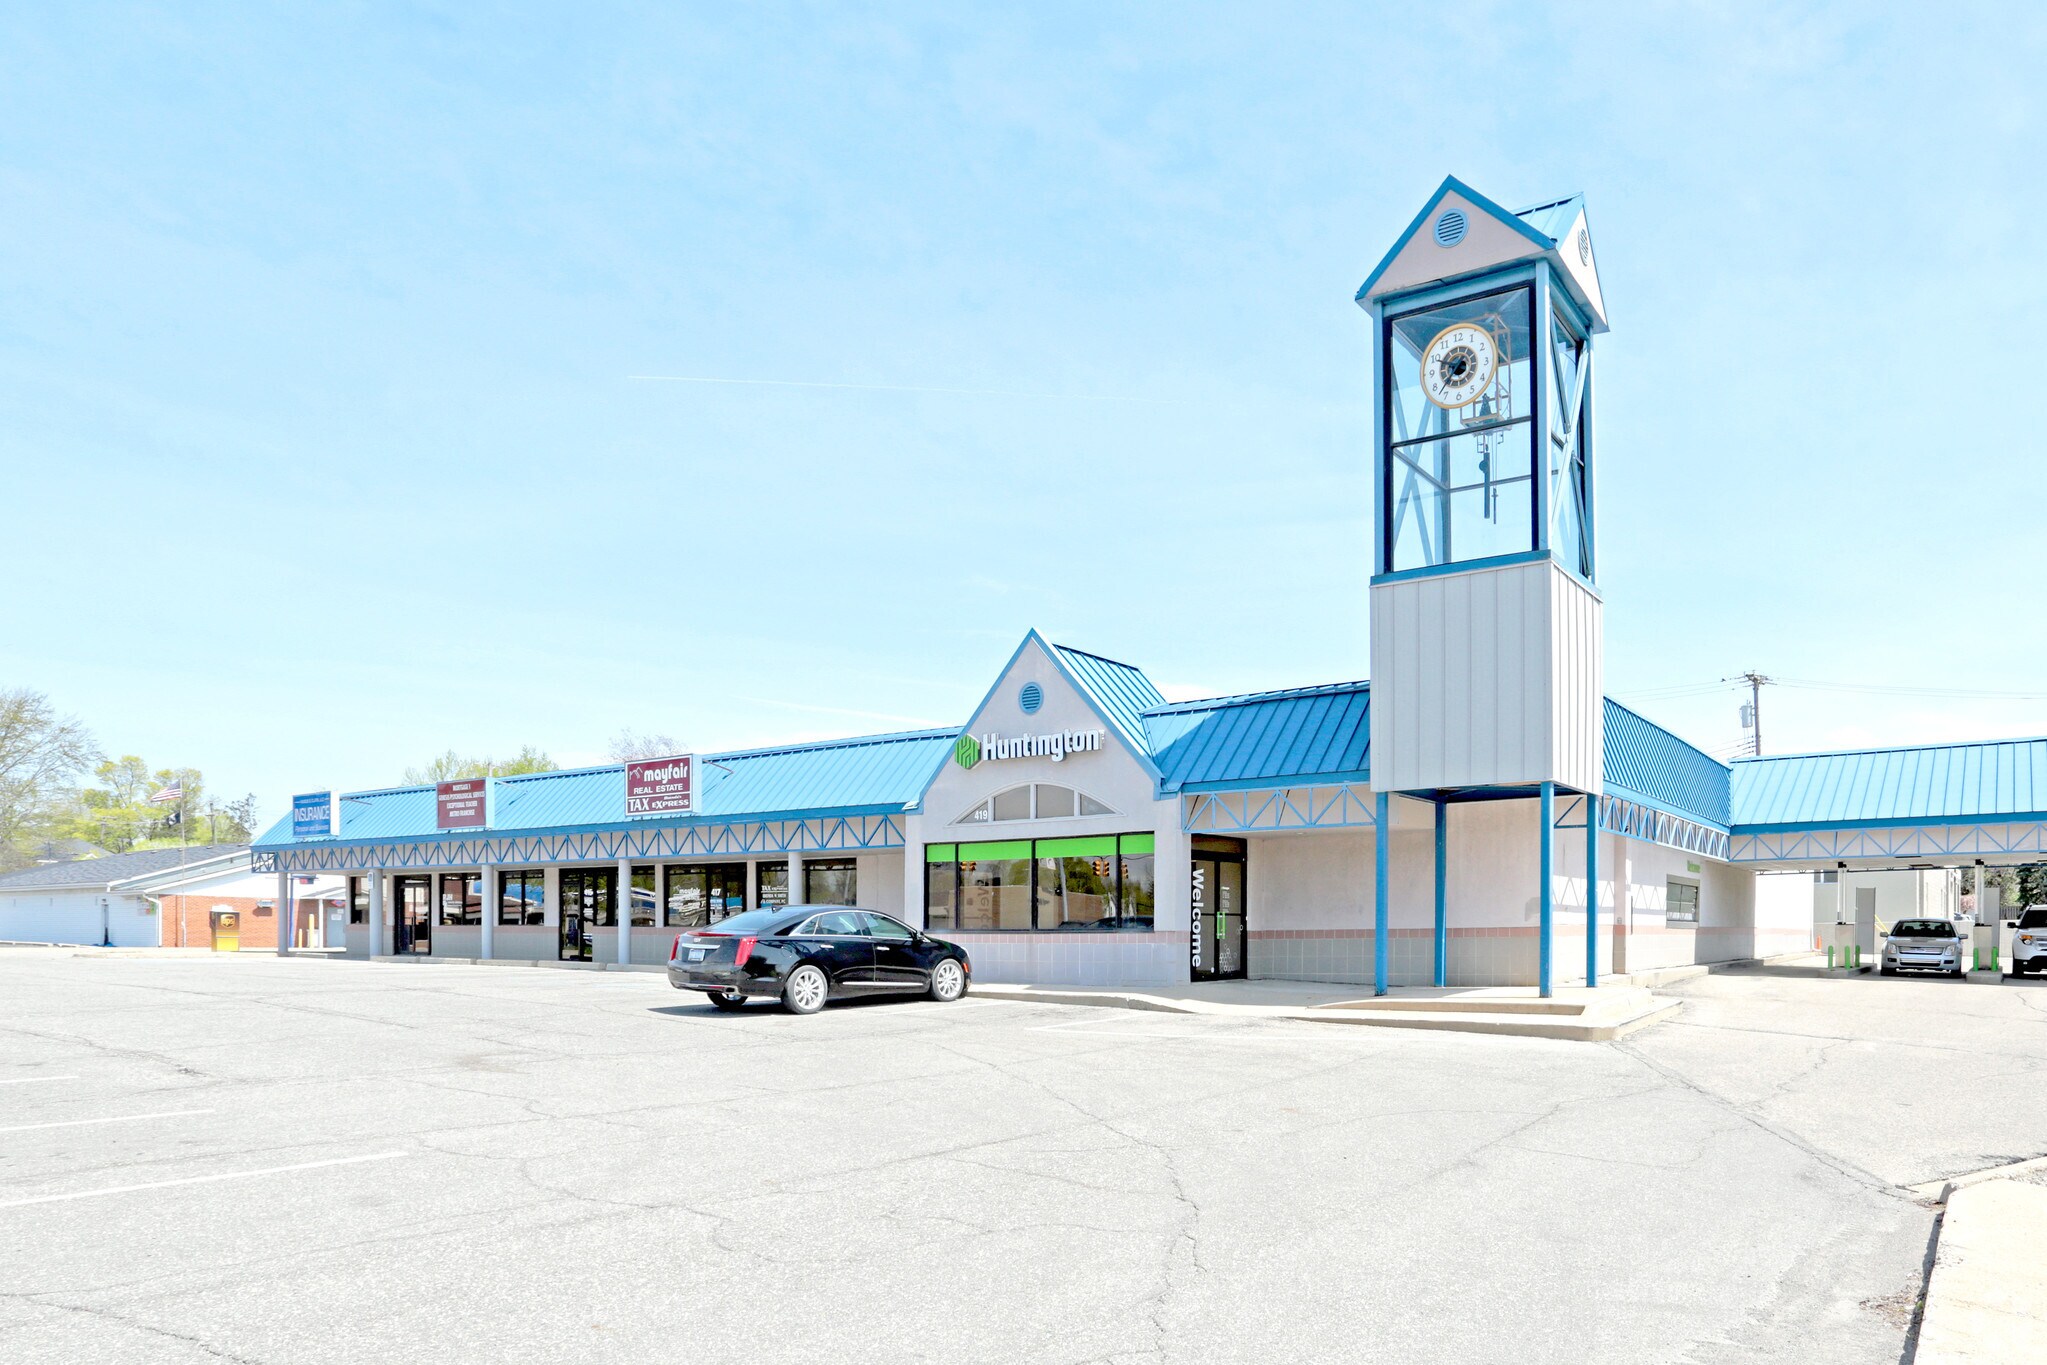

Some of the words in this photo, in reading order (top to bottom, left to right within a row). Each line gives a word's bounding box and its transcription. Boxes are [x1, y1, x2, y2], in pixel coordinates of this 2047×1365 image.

[1453, 332, 1464, 342] 12
[1470, 334, 1474, 342] 1
[1440, 340, 1449, 350] 11
[1480, 342, 1486, 352] 2
[1430, 354, 1440, 364] 10
[1484, 356, 1489, 366] 3
[1429, 370, 1435, 378] 9
[1480, 373, 1485, 381] 4
[1432, 383, 1438, 392] 8
[1470, 385, 1475, 394] 5
[1443, 392, 1449, 400] 7
[1456, 392, 1462, 400] 6
[982, 728, 1099, 762] Huntington
[644, 762, 688, 784] mayfair
[634, 786, 653, 794] REAL
[656, 784, 683, 792] ESTATE
[628, 798, 650, 812] TAX
[652, 799, 689, 810] EXPRESS
[294, 805, 330, 822] INSURANCE
[974, 810, 988, 820] 419
[1192, 868, 1204, 968] Welcome
